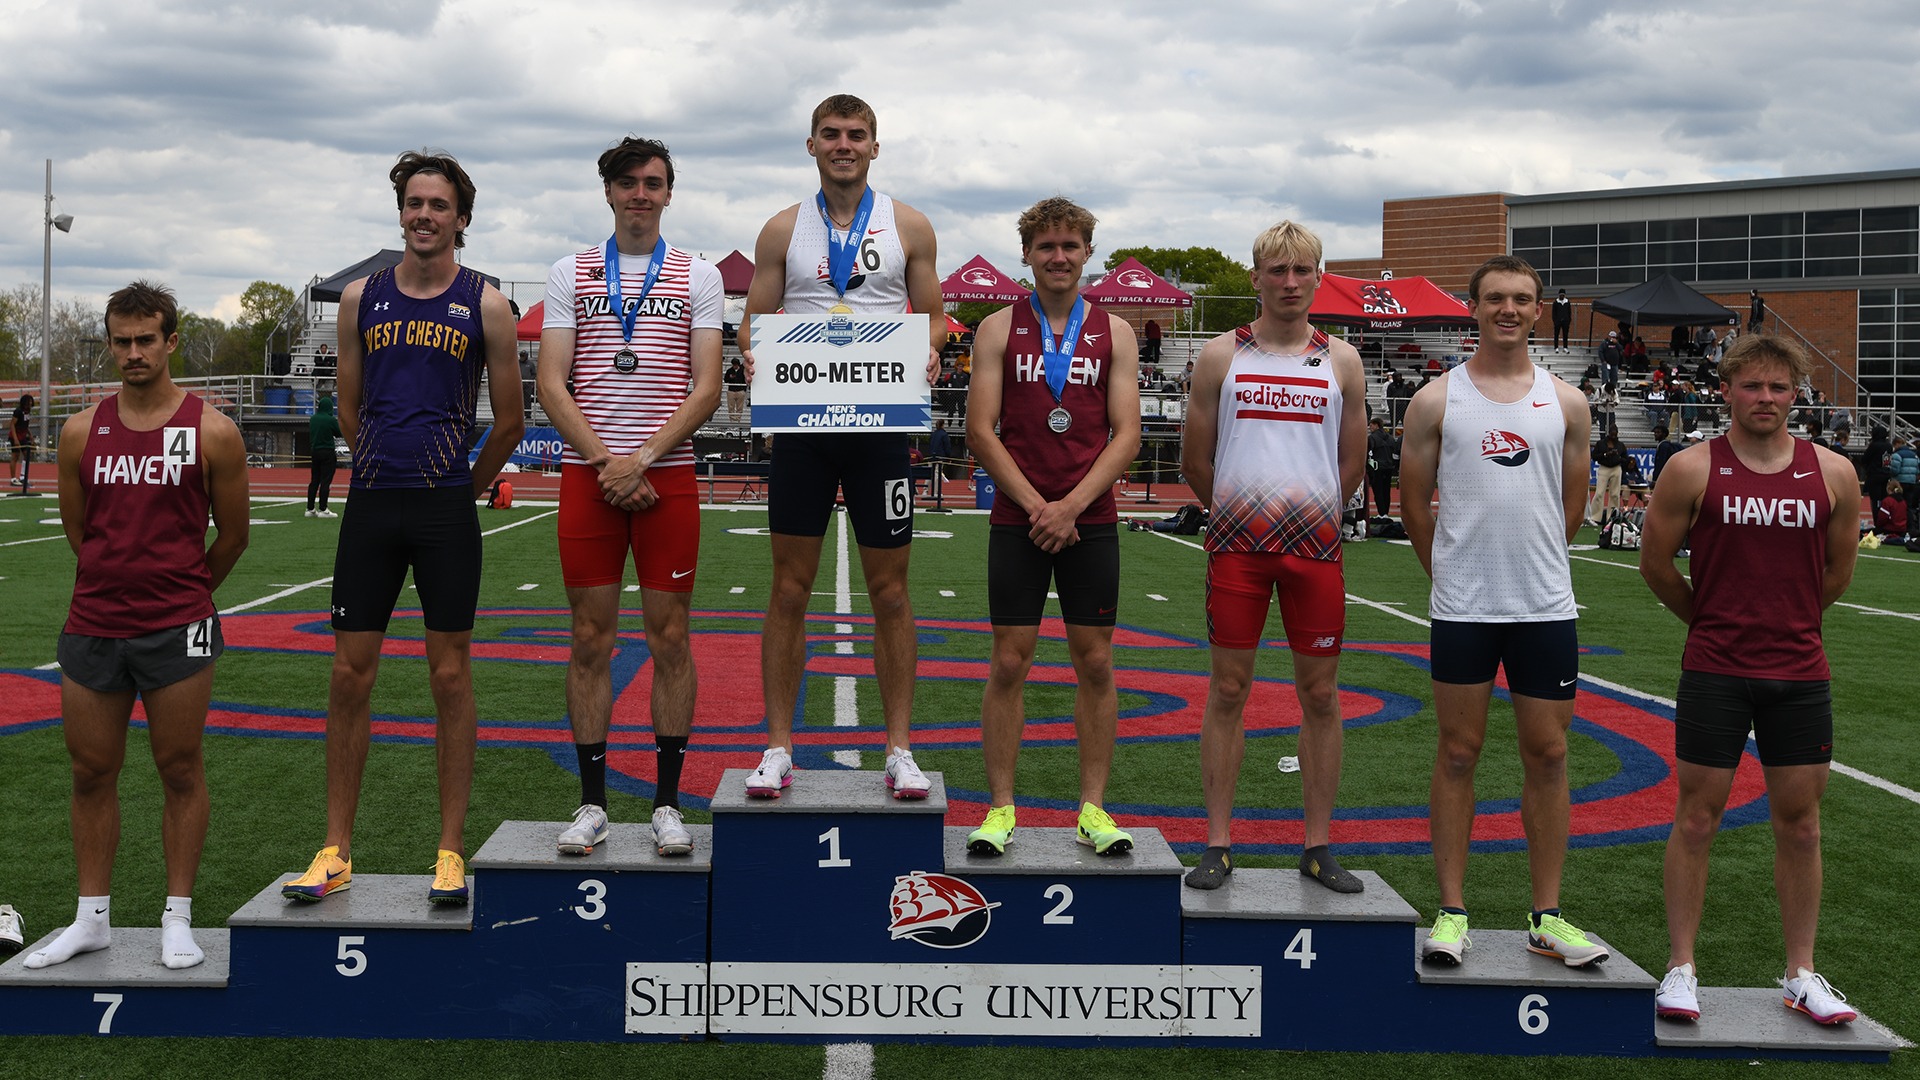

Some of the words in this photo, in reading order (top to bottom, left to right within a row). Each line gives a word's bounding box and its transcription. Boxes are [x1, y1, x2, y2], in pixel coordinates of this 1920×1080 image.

[860, 238, 881, 272] 6
[449, 306, 470, 316] PSAC
[580, 296, 684, 320] VUCANS
[1370, 320, 1403, 329] VULCANS
[364, 320, 403, 357] WEST
[405, 319, 469, 363] CHESTER
[775, 362, 905, 384] 800-METER
[1015, 354, 1101, 387] HAEN
[826, 404, 857, 414] MEN'S
[1241, 385, 1321, 410] edinboro
[796, 413, 886, 427] CHAMPION
[168, 430, 191, 463] 4
[93, 455, 182, 486] HAVEN
[891, 481, 907, 517] 6
[1723, 495, 1816, 528] HAVEN
[192, 619, 209, 655] 4
[818, 826, 851, 868] 1
[574, 879, 607, 921] 3
[1042, 884, 1075, 925] 2
[335, 935, 368, 977] 5
[1283, 928, 1318, 970] 4
[92, 993, 124, 1034] 7
[630, 976, 963, 1018] SHIPPENSBURG
[987, 985, 1255, 1020] UNIVERSITY
[1517, 993, 1550, 1035] 6
